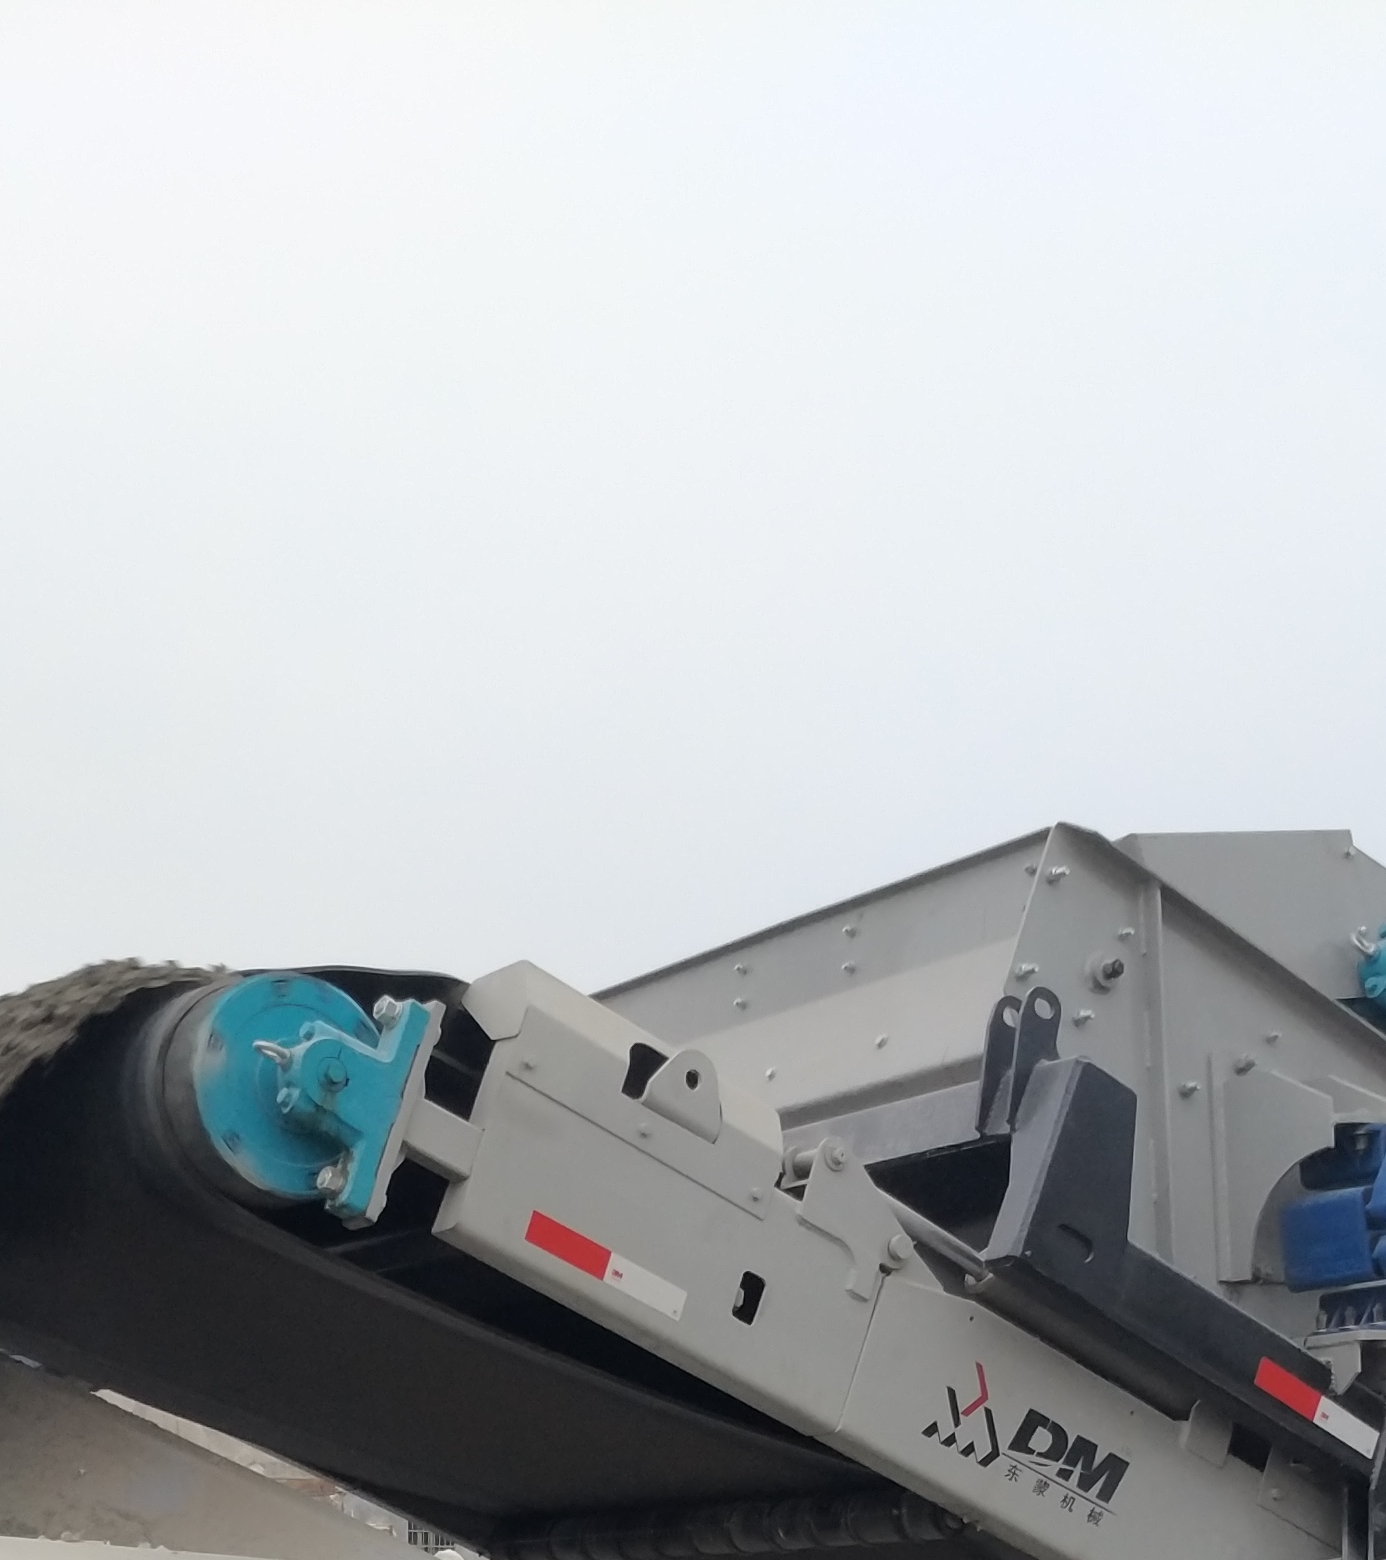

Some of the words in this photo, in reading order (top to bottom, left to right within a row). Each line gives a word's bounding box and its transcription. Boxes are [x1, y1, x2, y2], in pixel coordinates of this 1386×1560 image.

[1004, 1463, 1105, 1527] 东蒙机械
[1006, 1408, 1131, 1505] DM
